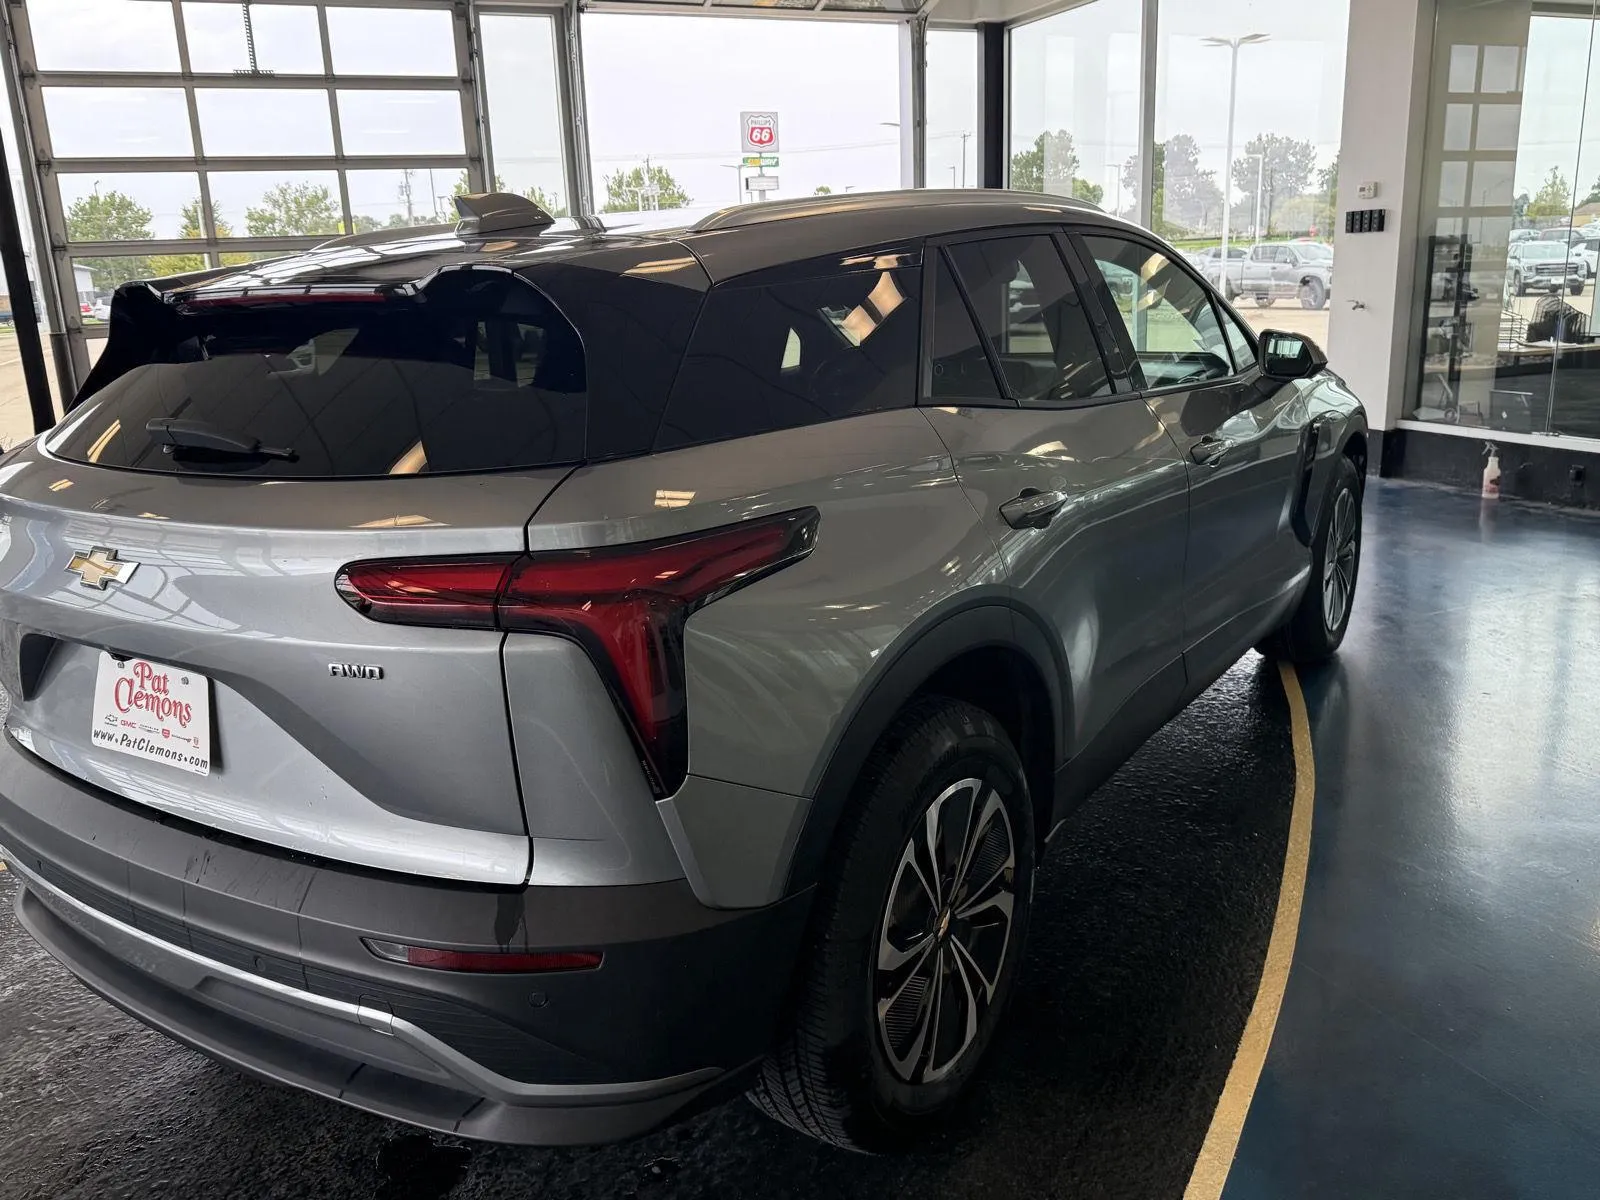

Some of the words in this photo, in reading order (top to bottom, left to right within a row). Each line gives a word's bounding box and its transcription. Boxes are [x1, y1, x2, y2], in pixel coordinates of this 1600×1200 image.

[752, 128, 771, 142] 66
[133, 661, 169, 696] Pat
[328, 663, 385, 680] AWD
[114, 677, 192, 729] Clemons
[120, 719, 137, 729] GMC
